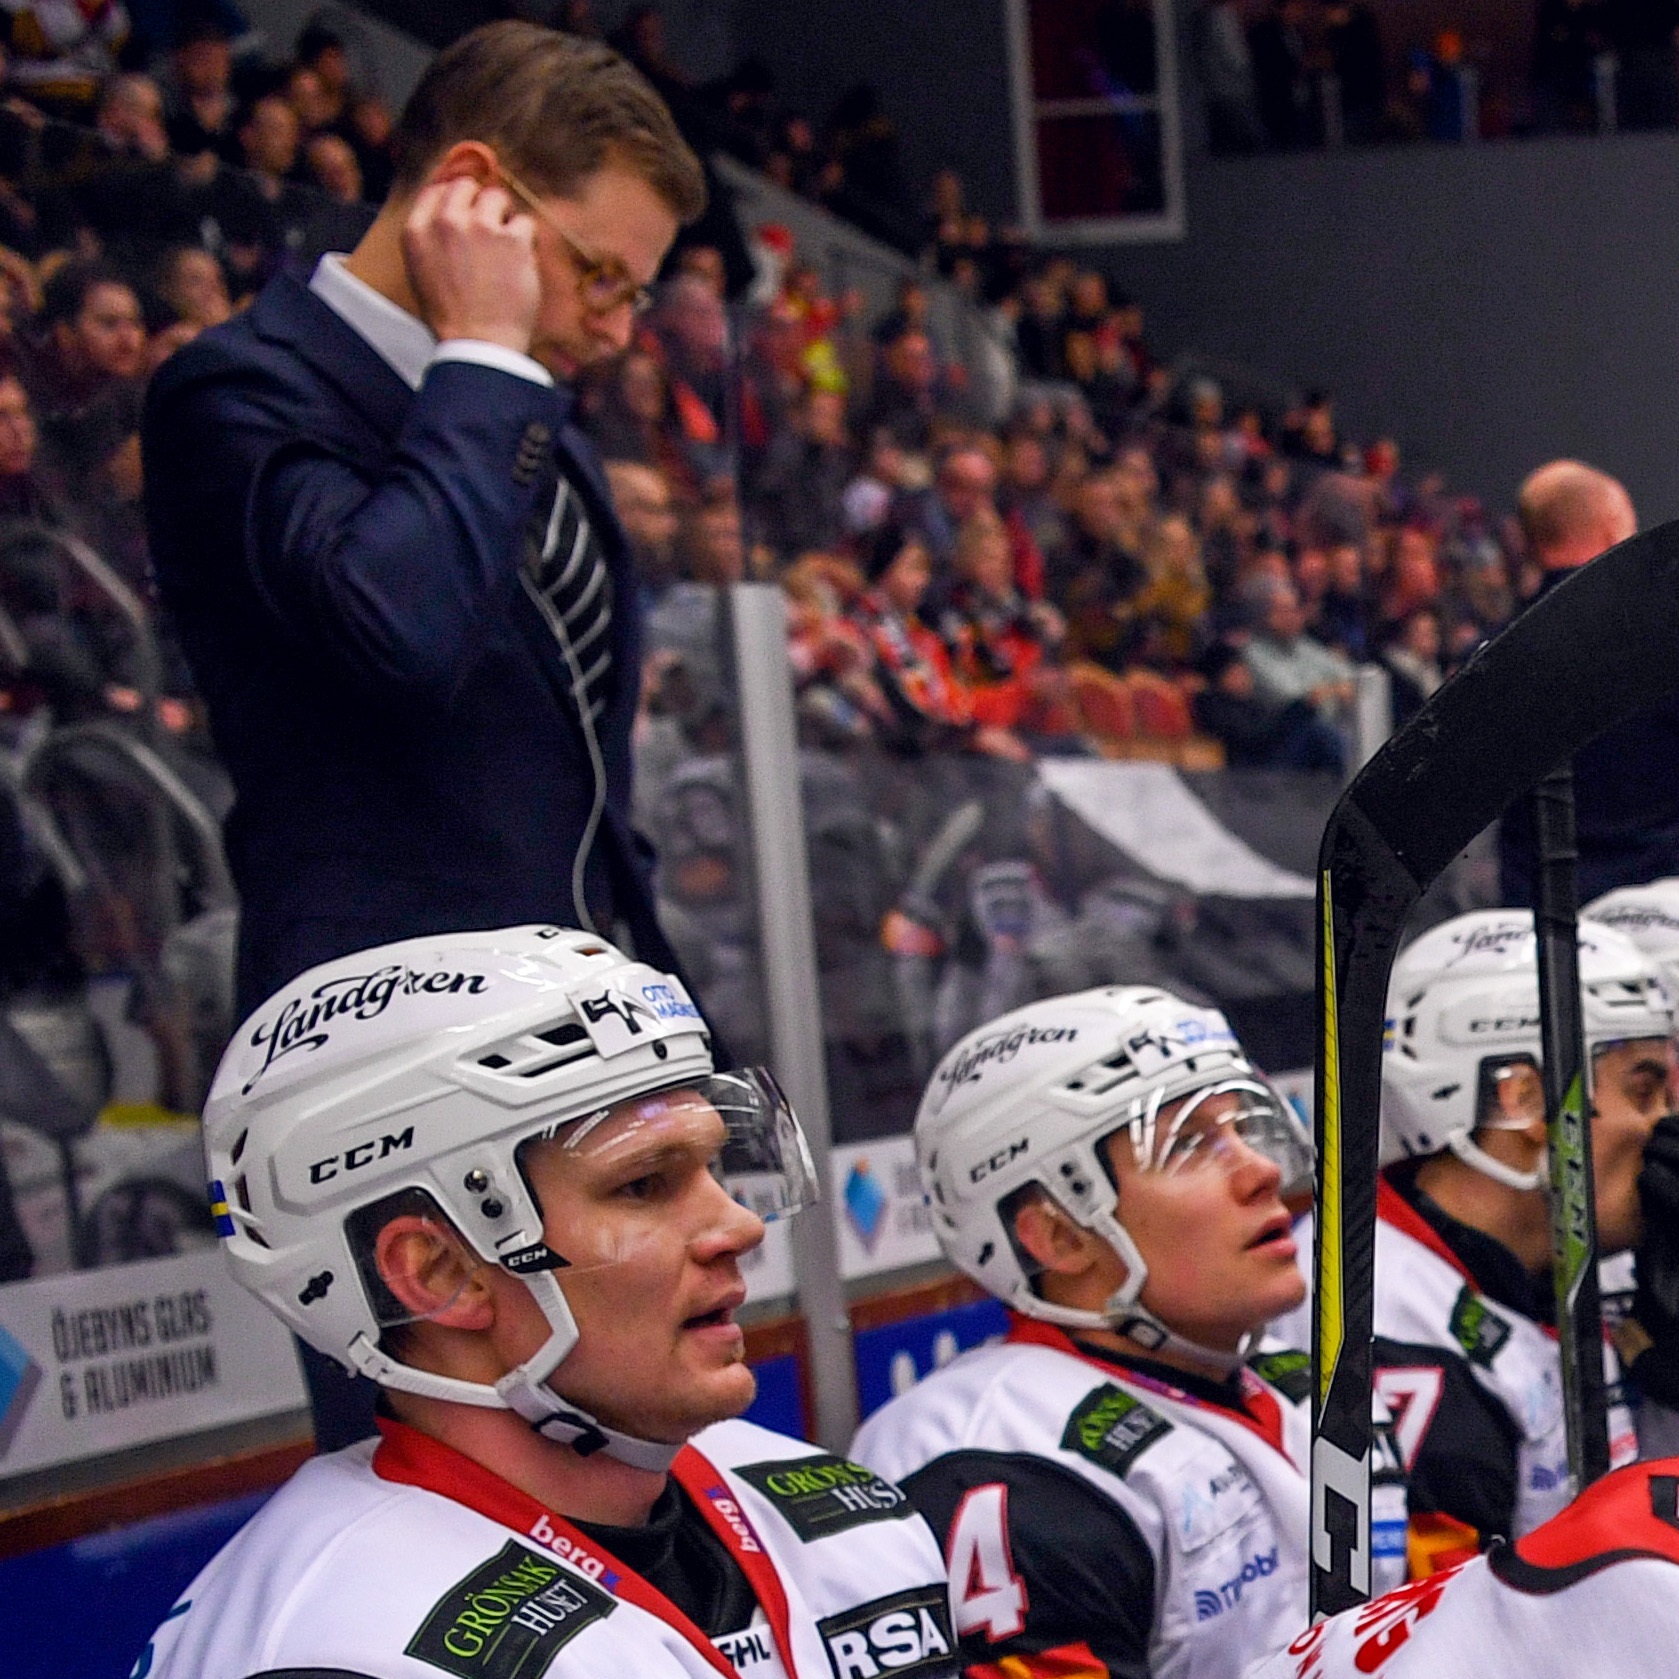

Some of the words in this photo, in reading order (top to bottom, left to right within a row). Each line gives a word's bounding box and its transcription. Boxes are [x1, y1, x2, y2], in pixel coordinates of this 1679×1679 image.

[241, 965, 489, 1096] Landgren
[308, 1125, 416, 1185] CCM
[969, 1136, 1030, 1184] CCM
[507, 1247, 548, 1269] CCM
[950, 1482, 1030, 1644] 4
[443, 1554, 558, 1659] GRÖNSAK
[511, 1578, 589, 1637] HUSET
